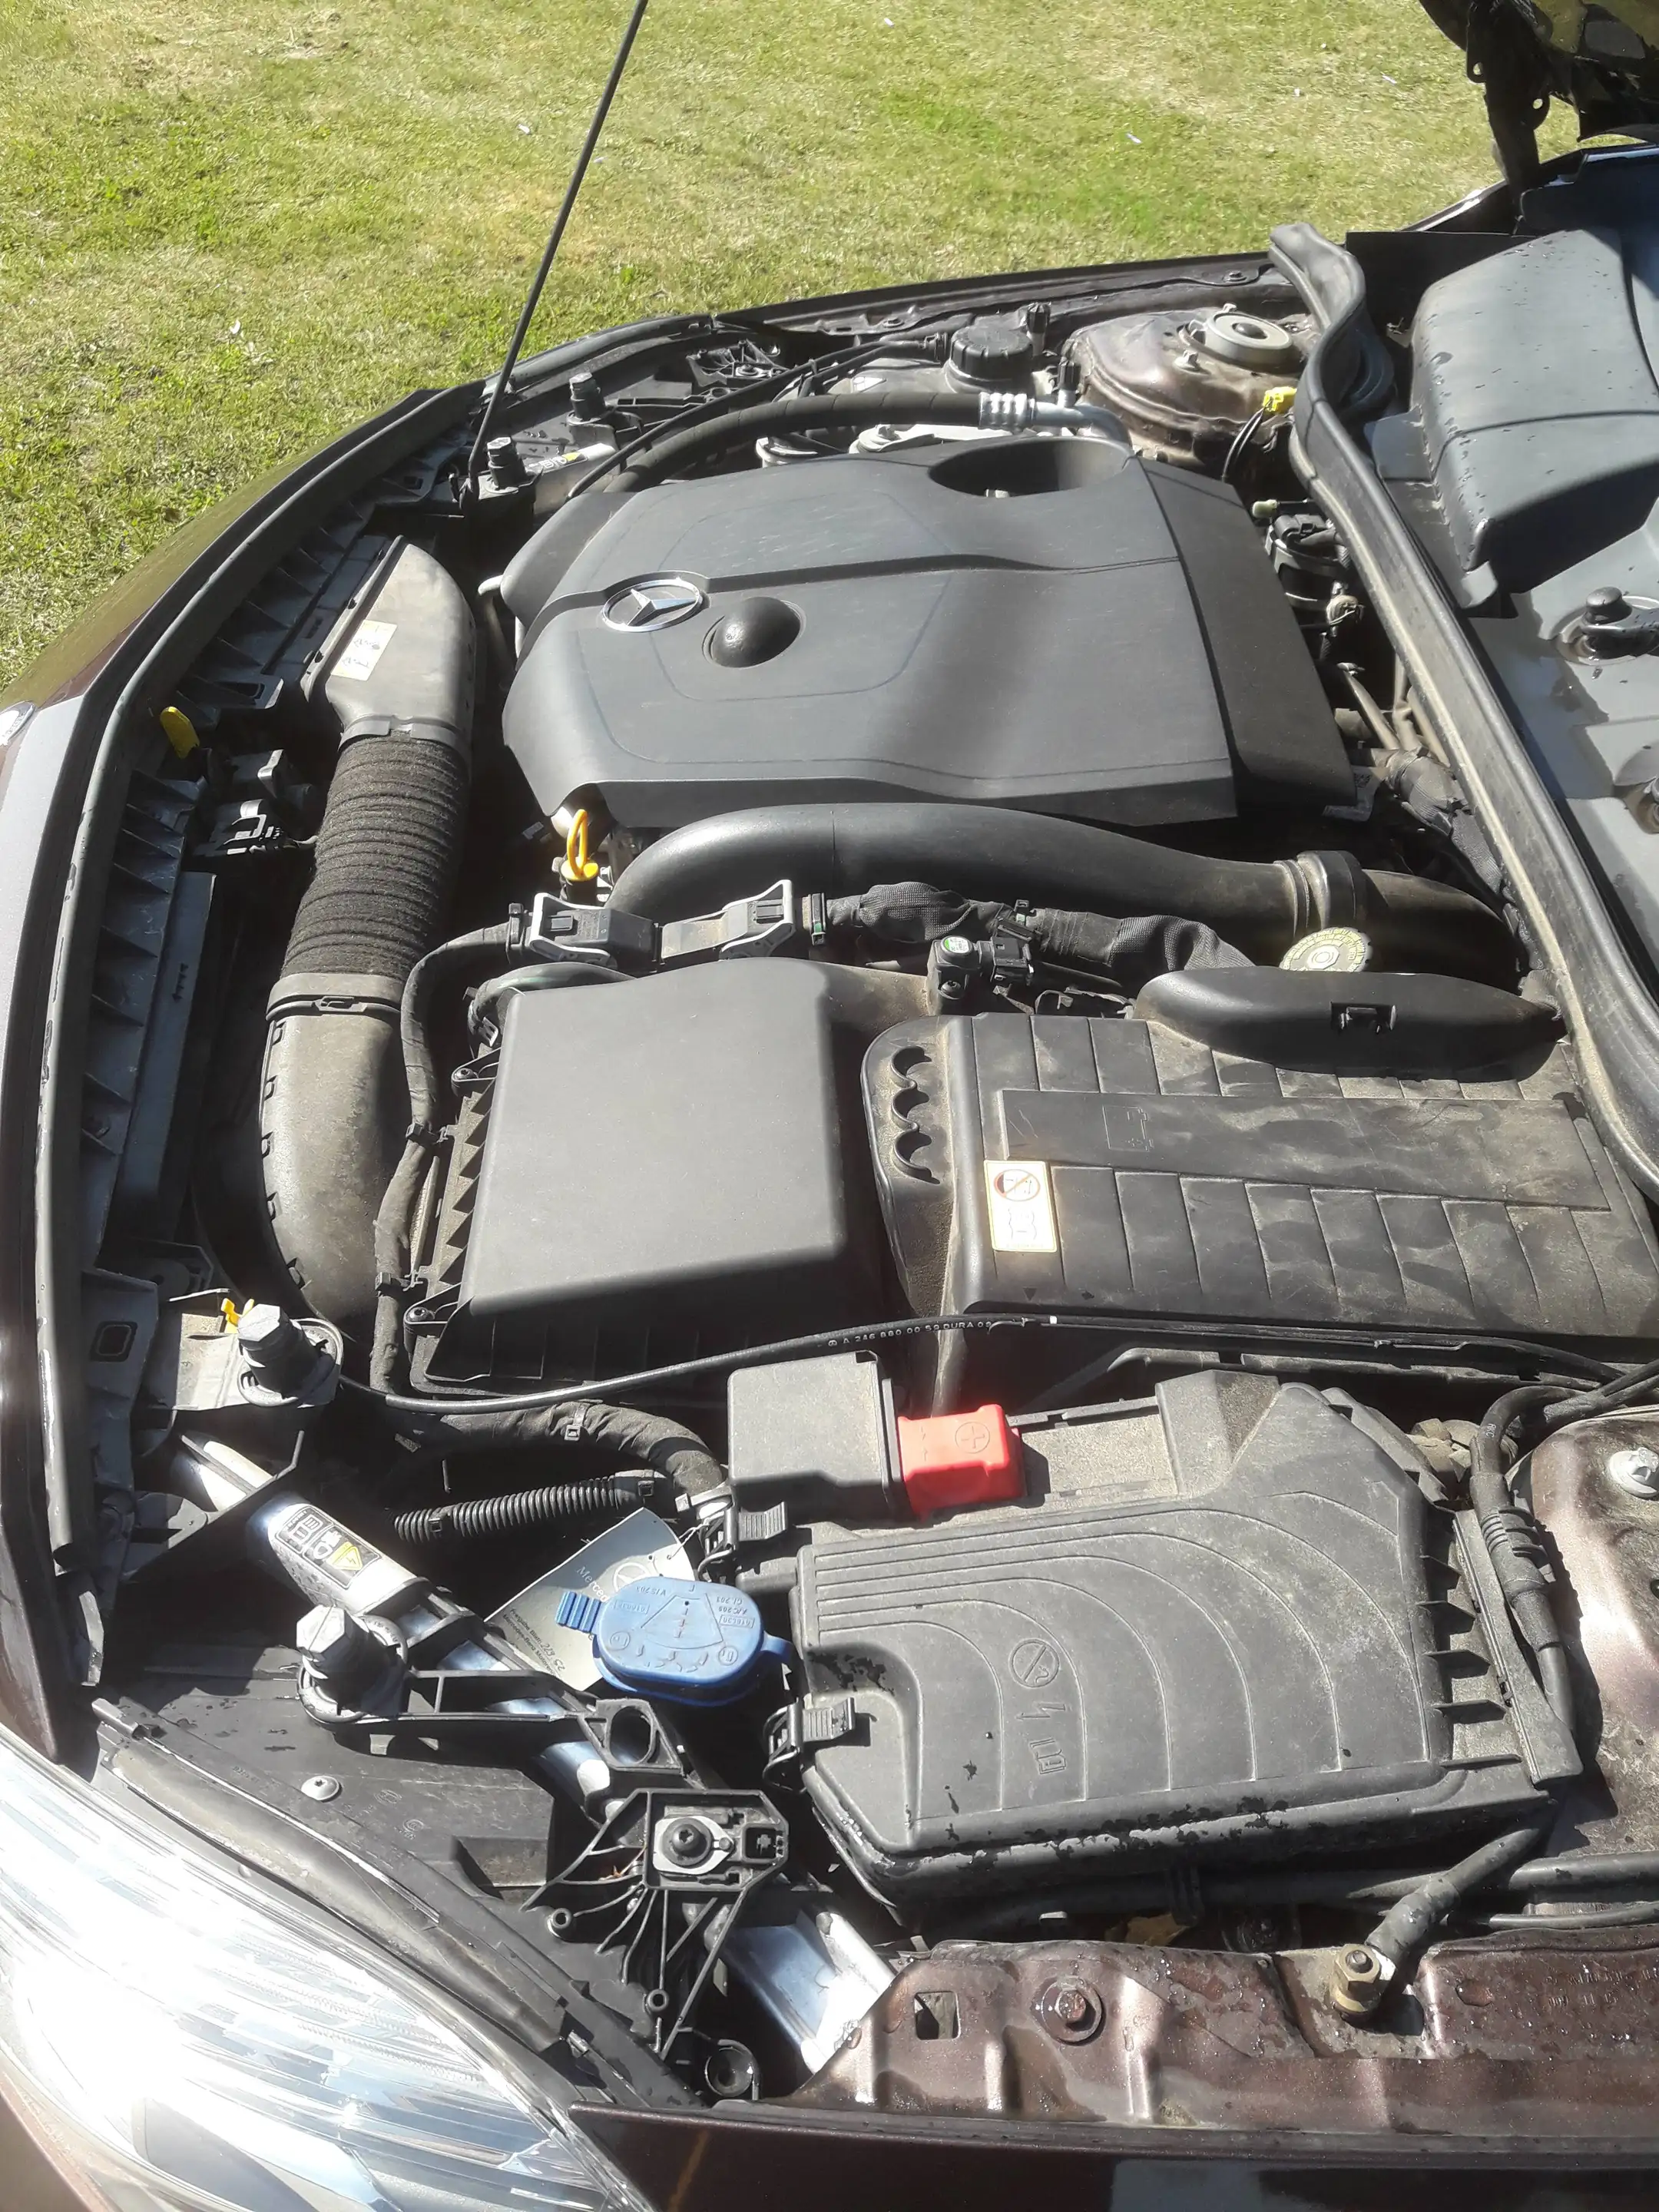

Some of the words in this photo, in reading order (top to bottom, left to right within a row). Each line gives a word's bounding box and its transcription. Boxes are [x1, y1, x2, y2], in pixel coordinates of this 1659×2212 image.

[855, 1333, 876, 1343] 246
[906, 1326, 921, 1335] 00
[943, 1320, 975, 1330] DURA
